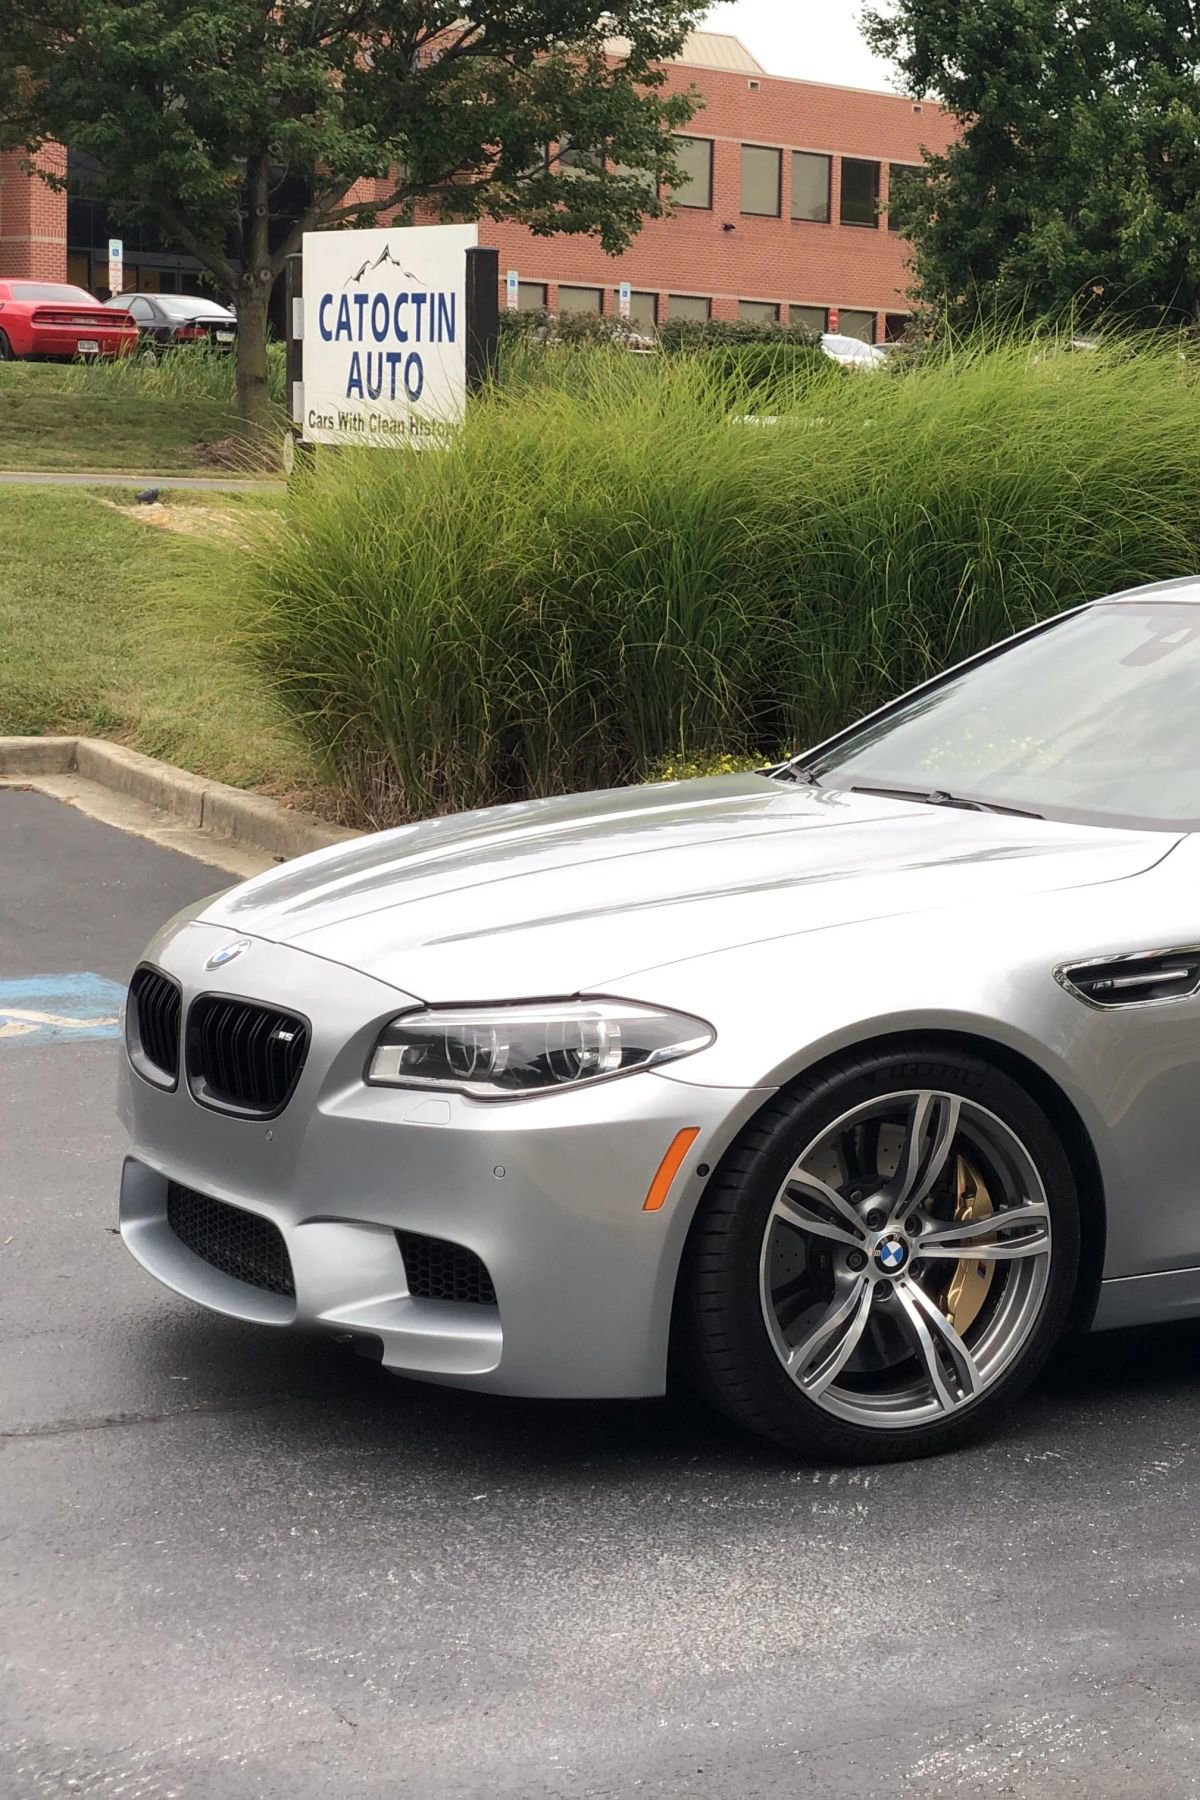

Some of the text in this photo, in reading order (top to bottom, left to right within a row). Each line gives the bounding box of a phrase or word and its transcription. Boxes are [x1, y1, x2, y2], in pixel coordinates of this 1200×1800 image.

[318, 292, 456, 343] CATOCTIN
[345, 351, 424, 402] AUTO
[308, 410, 334, 430] Cars
[337, 411, 365, 432] With
[369, 413, 405, 435] Clean
